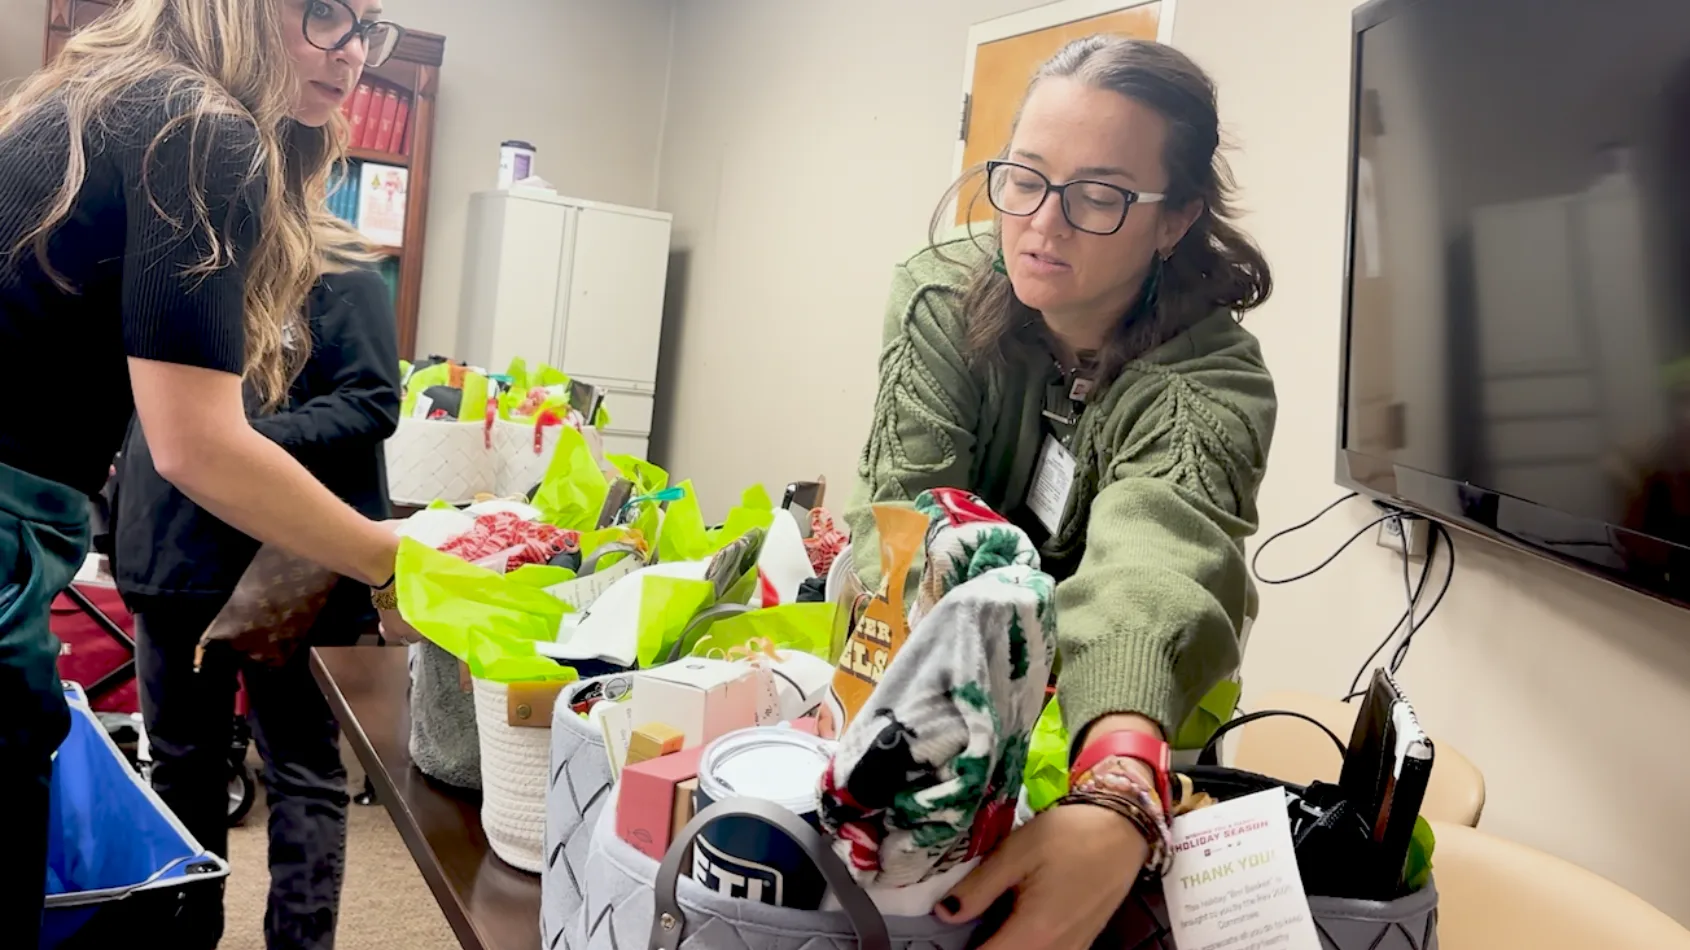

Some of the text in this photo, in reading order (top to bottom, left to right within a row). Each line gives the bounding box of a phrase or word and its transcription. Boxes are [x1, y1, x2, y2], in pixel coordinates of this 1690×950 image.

[1176, 820, 1269, 852] HOLIDAY SEASON
[692, 840, 762, 902] ETI
[1179, 849, 1276, 889] THANK YOU!
